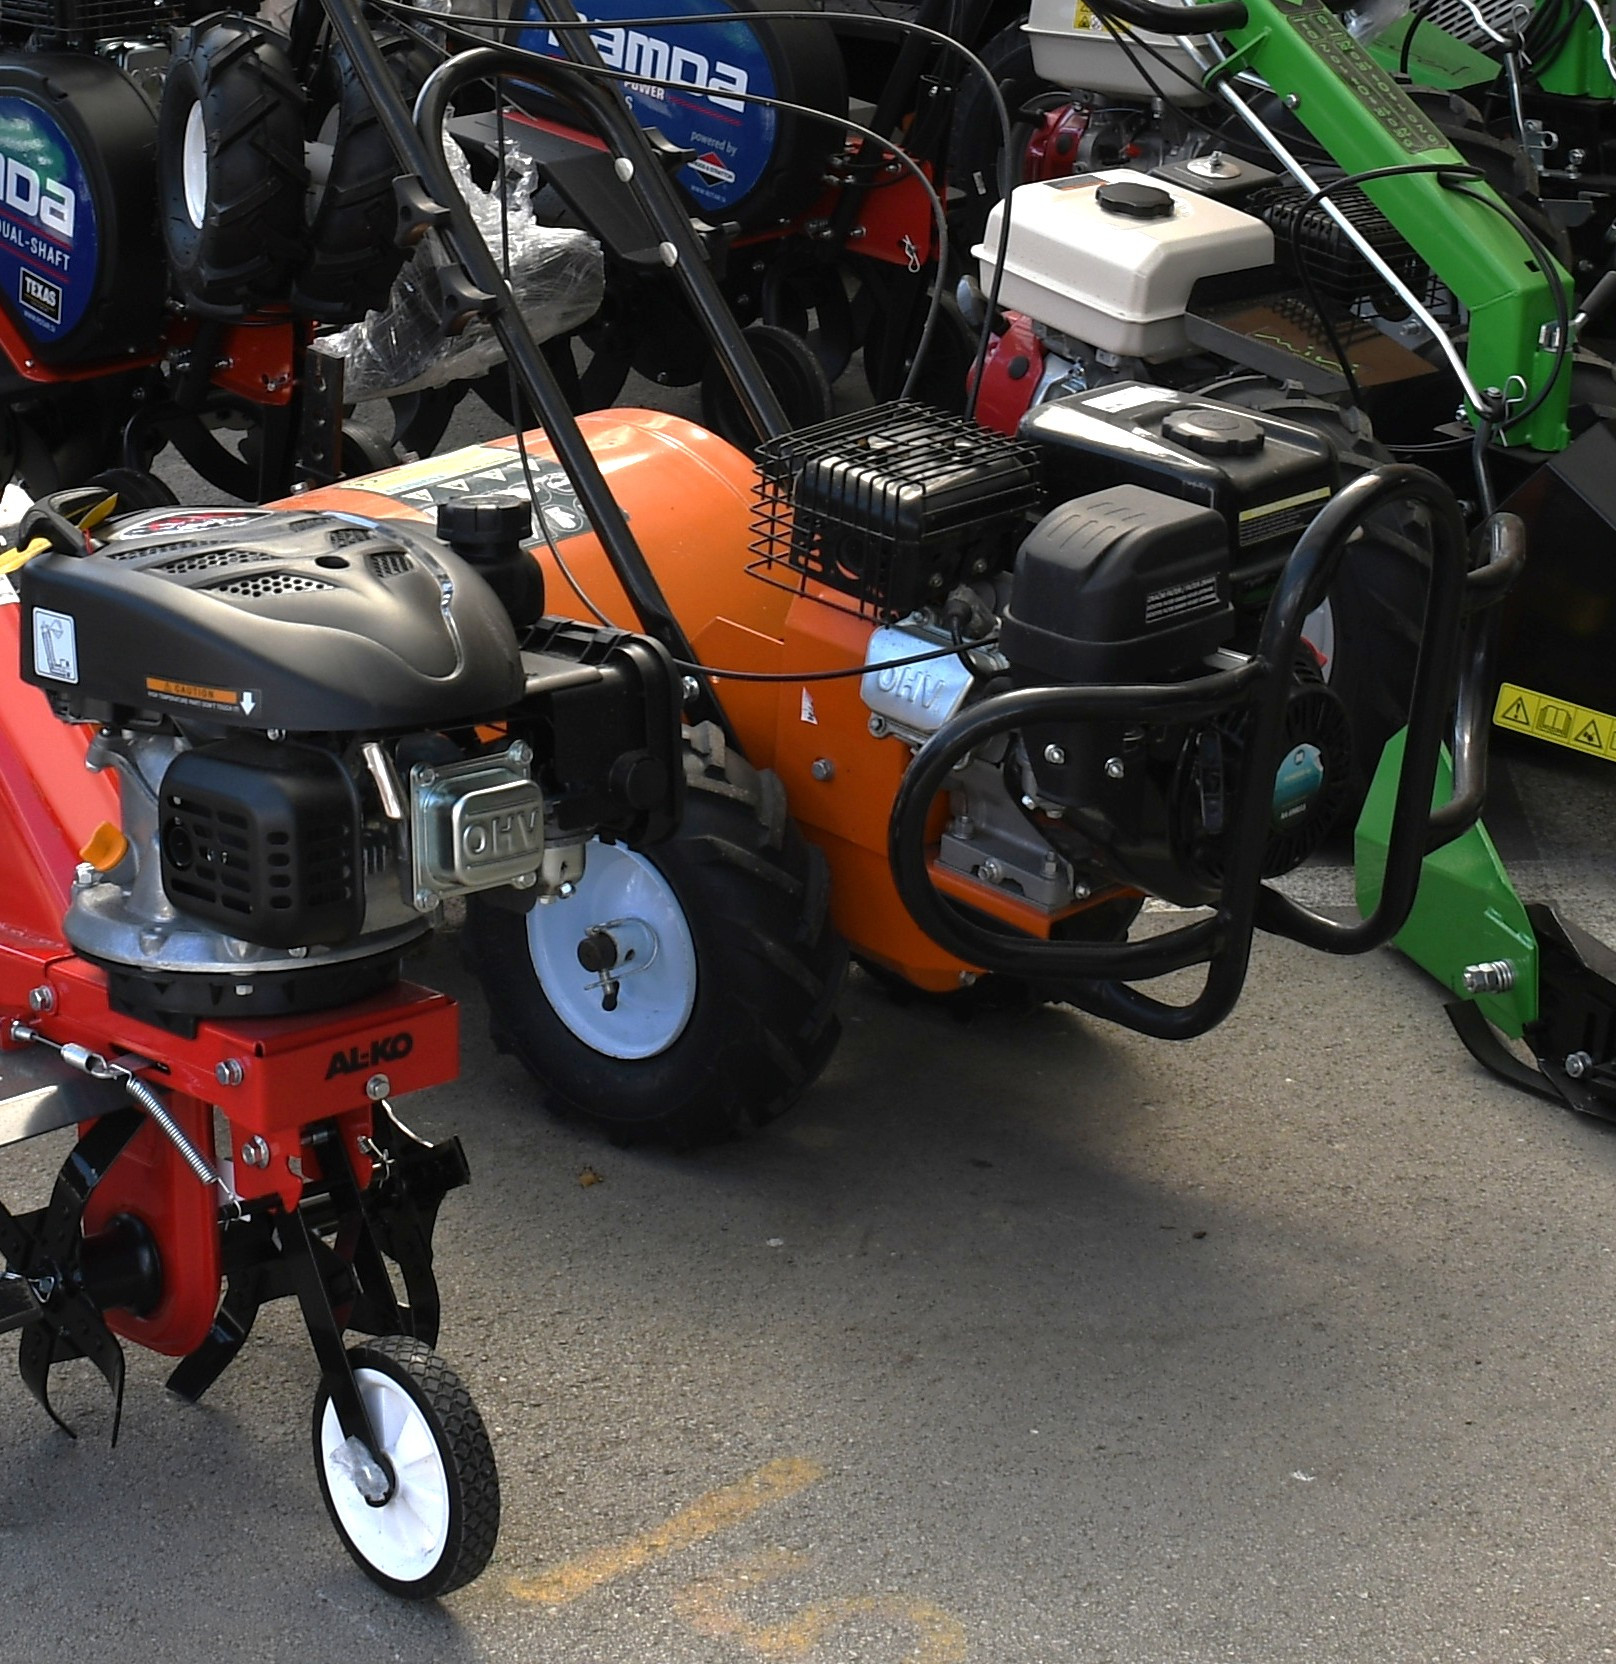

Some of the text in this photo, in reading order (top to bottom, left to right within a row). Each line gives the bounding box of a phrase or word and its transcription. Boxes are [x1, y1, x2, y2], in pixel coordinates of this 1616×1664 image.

[624, 80, 665, 101] POWER
[690, 131, 739, 158] powered by
[24, 276, 57, 307] TEXAS
[174, 682, 215, 699] CAUTION
[876, 665, 946, 710] OHV
[463, 807, 540, 856] OHV
[324, 1032, 413, 1080] AL-KO
